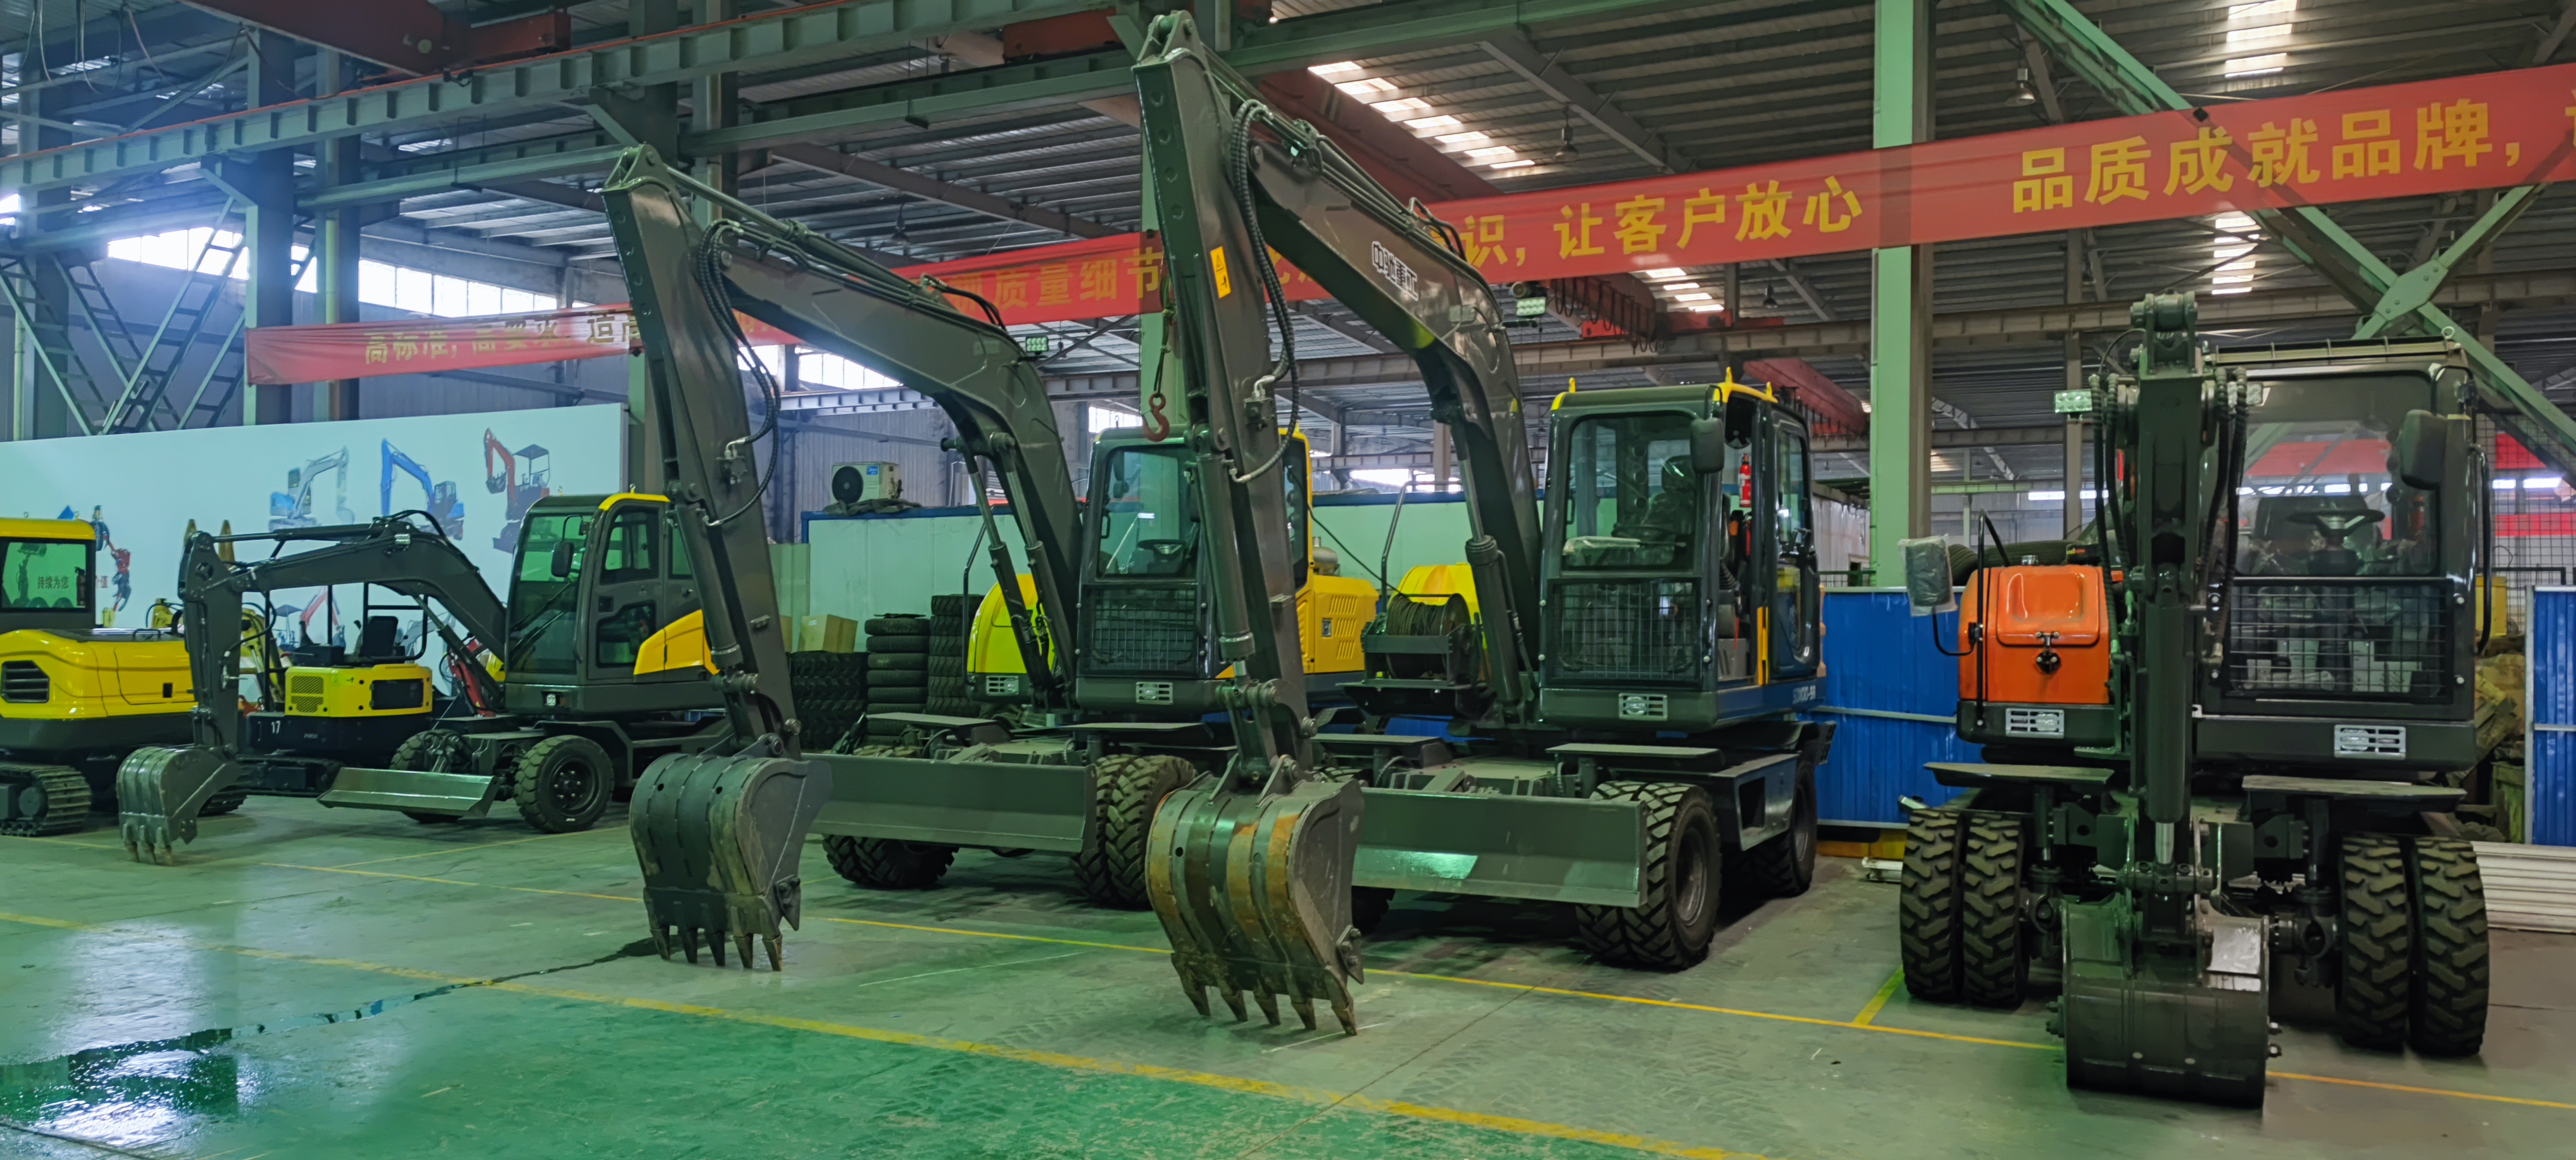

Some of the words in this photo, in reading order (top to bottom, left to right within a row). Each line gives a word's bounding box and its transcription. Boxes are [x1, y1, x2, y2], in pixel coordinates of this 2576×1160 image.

[1430, 176, 1862, 268] 识，让客户放心
[271, 720, 280, 734] 17
